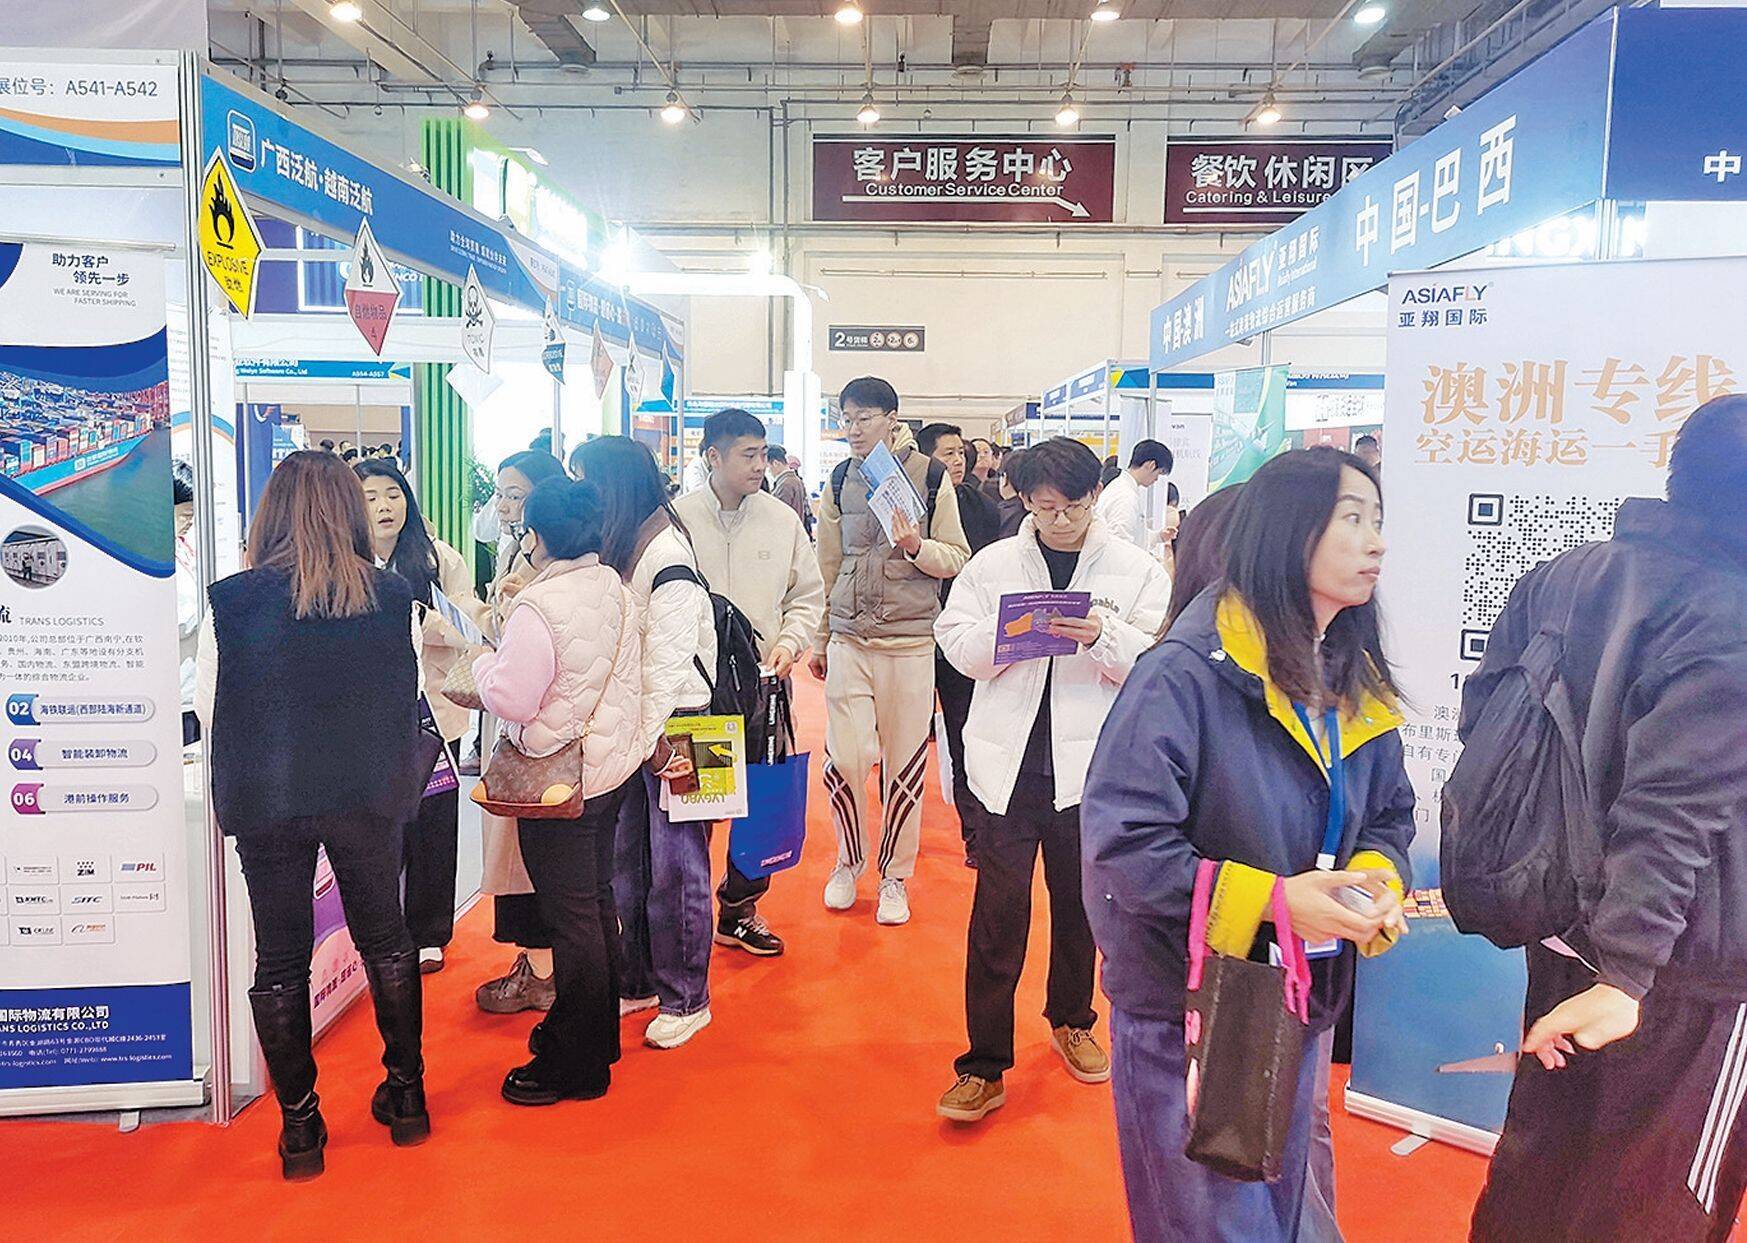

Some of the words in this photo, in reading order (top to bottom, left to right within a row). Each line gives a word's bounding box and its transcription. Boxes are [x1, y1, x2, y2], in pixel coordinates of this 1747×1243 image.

[65, 79, 158, 96] A541-A542
[852, 147, 1073, 183] 客户服务中心
[1702, 149, 1741, 183] 中
[865, 183, 944, 197] Customer
[945, 183, 1007, 197] Service
[1008, 182, 1064, 197] Center
[1186, 190, 1253, 206] Catering
[1257, 191, 1269, 204] &
[1273, 190, 1331, 204] Leisure
[52, 253, 109, 268] 助力客户
[73, 270, 130, 286] 领先一步
[53, 288, 65, 296] WE
[66, 288, 80, 296] ARE
[1401, 283, 1488, 304] ASIAFLY
[1399, 308, 1488, 328] 亚翔国际
[1422, 354, 1739, 425] 澳洲专线
[20, 617, 51, 626] TRANS
[53, 617, 105, 626] LOGISTICS
[9, 701, 30, 715] 02
[10, 749, 32, 762] 04
[62, 749, 129, 760] 智能装卸物流
[14, 793, 36, 806] 06
[136, 863, 158, 872] PIL
[17, 1022, 70, 1033] LOGISTICS
